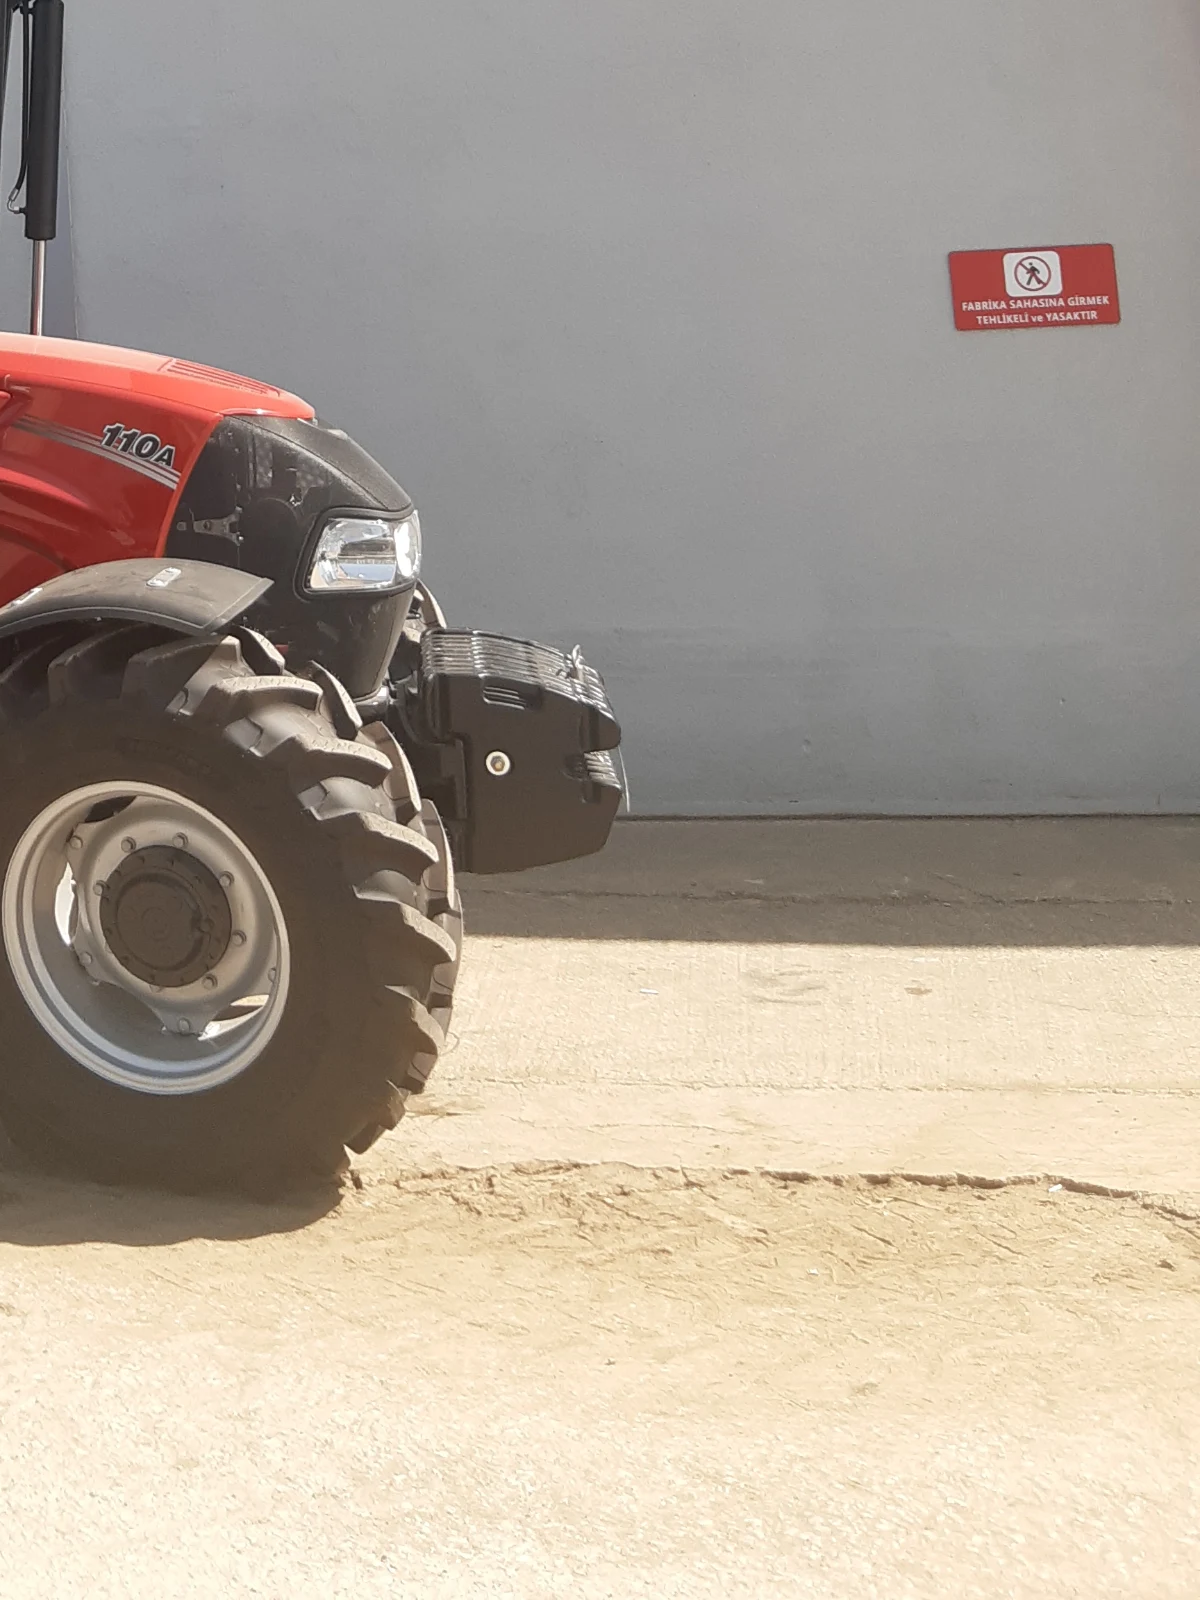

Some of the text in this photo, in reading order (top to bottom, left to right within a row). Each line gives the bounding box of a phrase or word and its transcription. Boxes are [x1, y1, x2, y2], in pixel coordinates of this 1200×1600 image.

[962, 294, 1110, 311] FABRİKA SAHASINA GİRMEK
[976, 310, 1098, 325] TEHLİKELİ ve YASAKTIR
[101, 422, 176, 469] 110A
